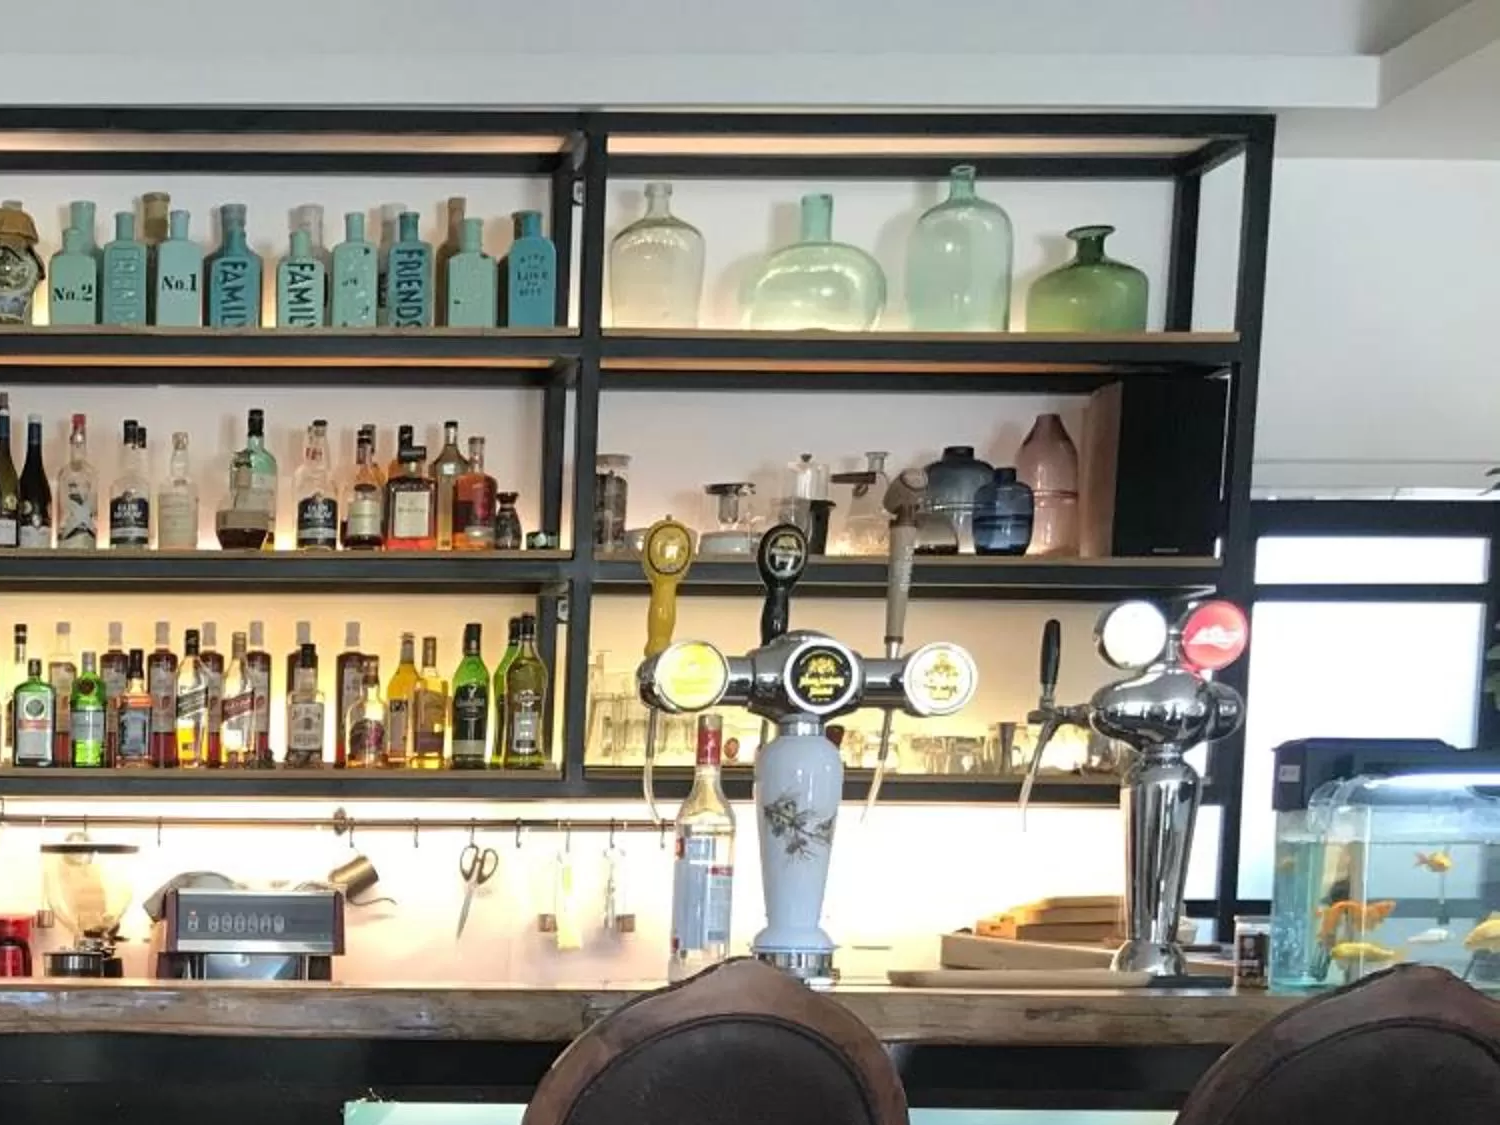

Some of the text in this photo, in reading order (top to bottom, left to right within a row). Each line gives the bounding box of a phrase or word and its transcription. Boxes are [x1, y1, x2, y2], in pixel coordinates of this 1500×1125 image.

[161, 273, 197, 292] No.1
[53, 284, 93, 302] No.2
[220, 261, 247, 326] FAMIL
